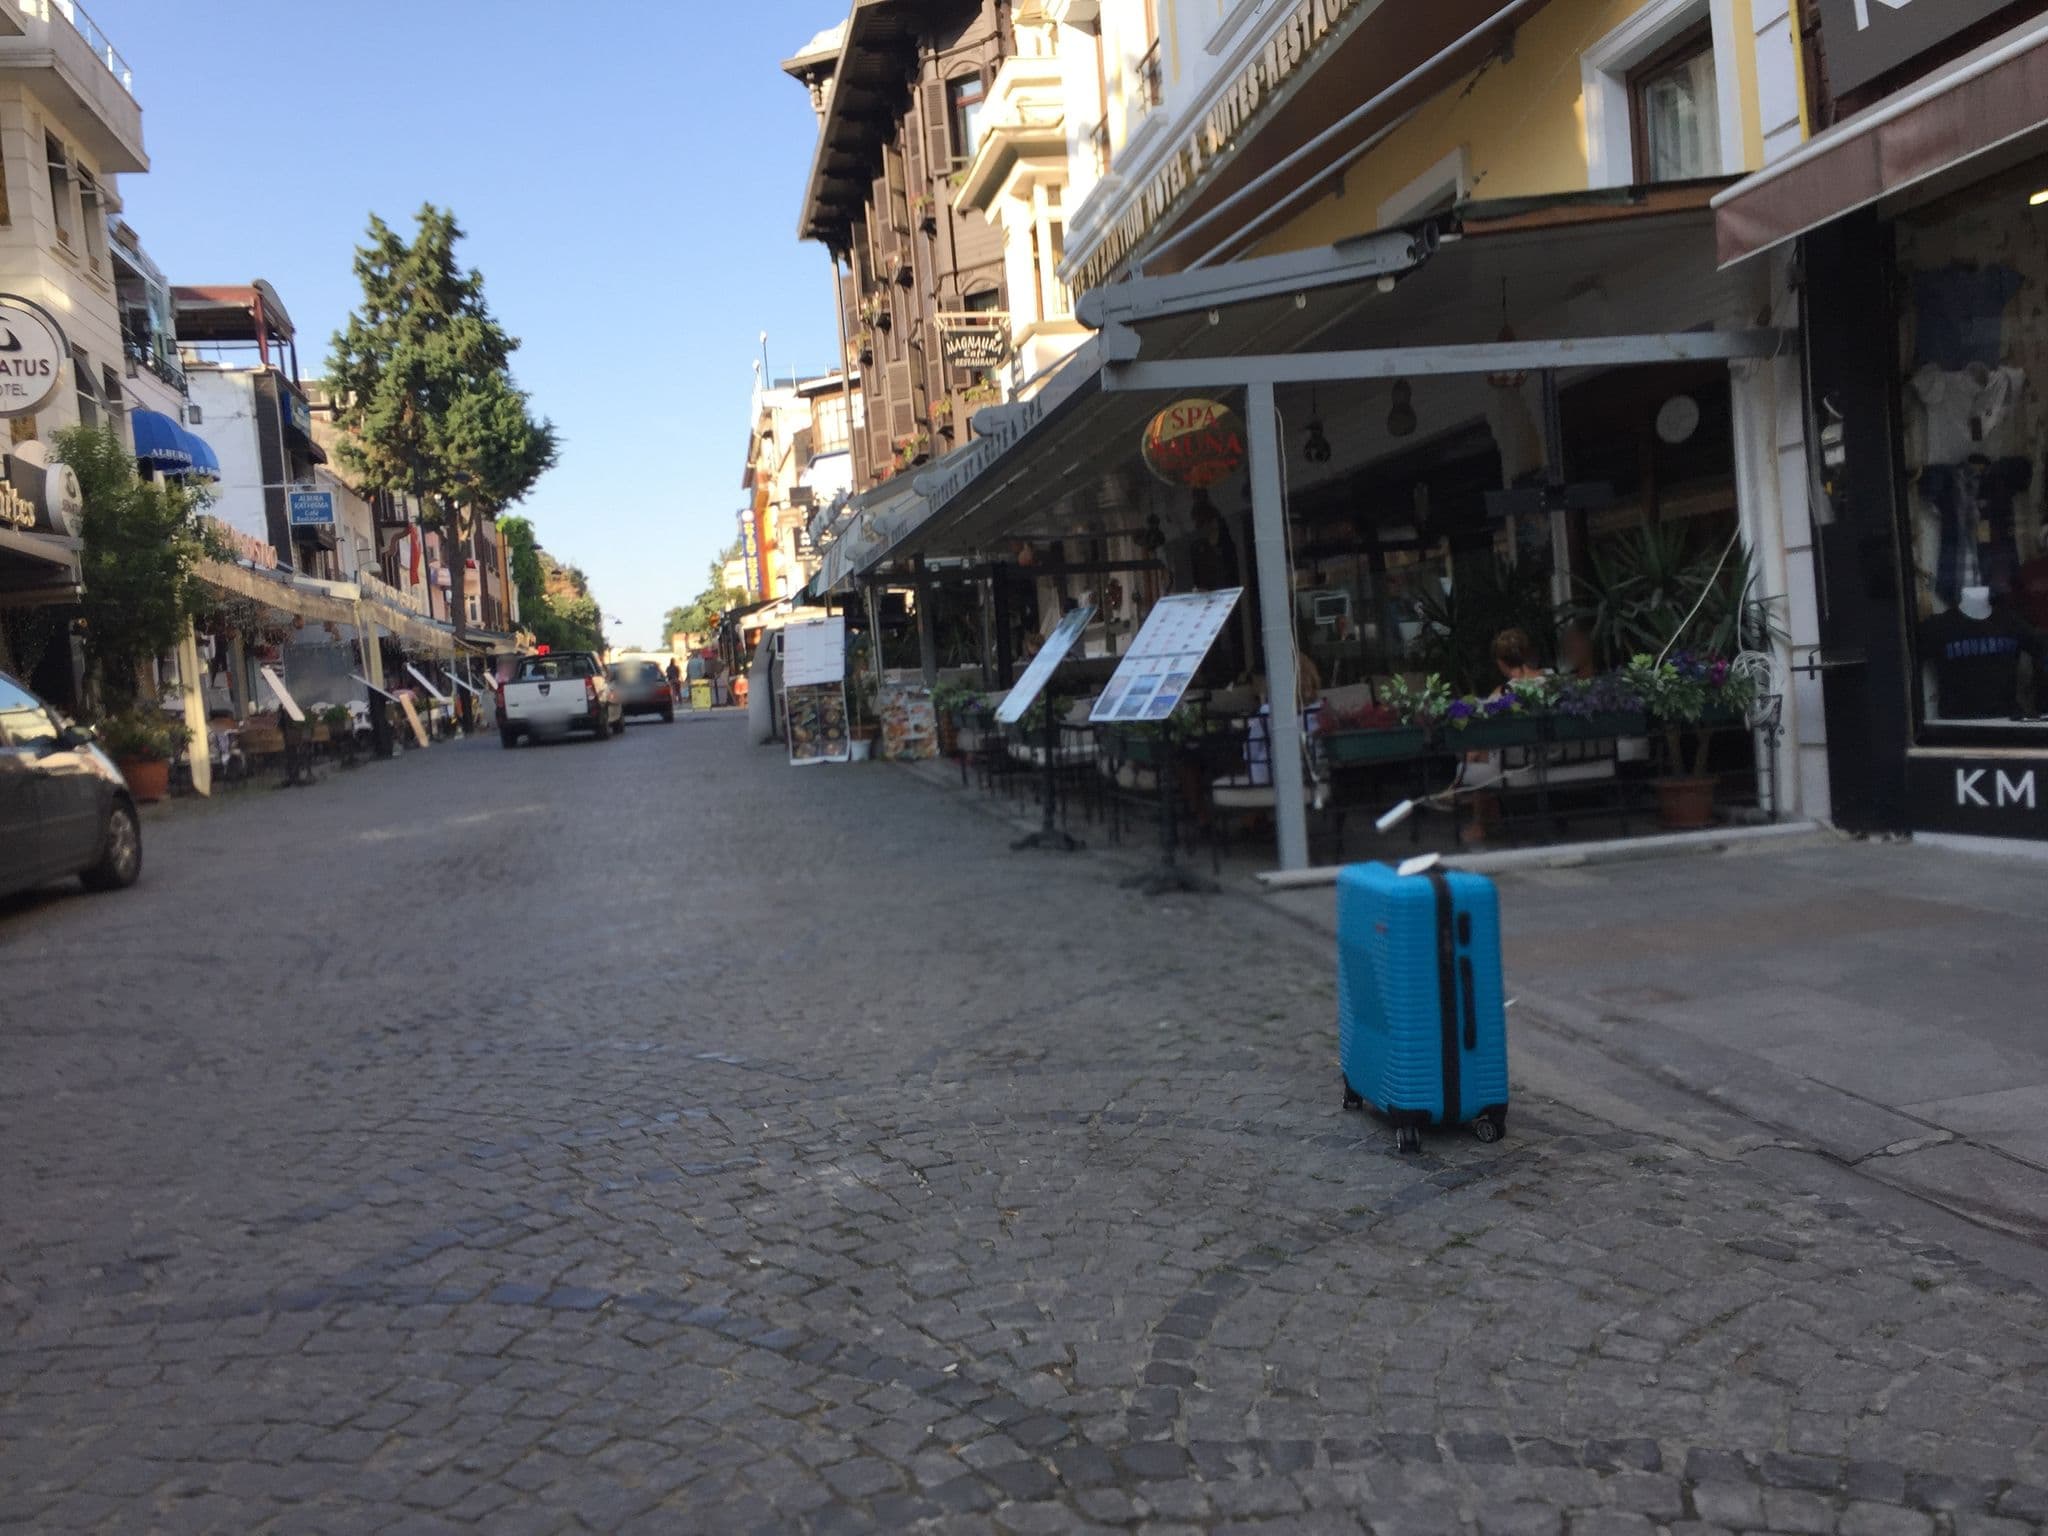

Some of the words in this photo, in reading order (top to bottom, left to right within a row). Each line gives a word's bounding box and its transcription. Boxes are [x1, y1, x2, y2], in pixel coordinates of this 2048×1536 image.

[1087, 196, 1146, 289] BYZANTIUM
[1145, 149, 1188, 224] HOTEL
[955, 357, 998, 367] RESTAURANT
[1171, 406, 1218, 429] SPA
[1956, 768, 2036, 809] KM
